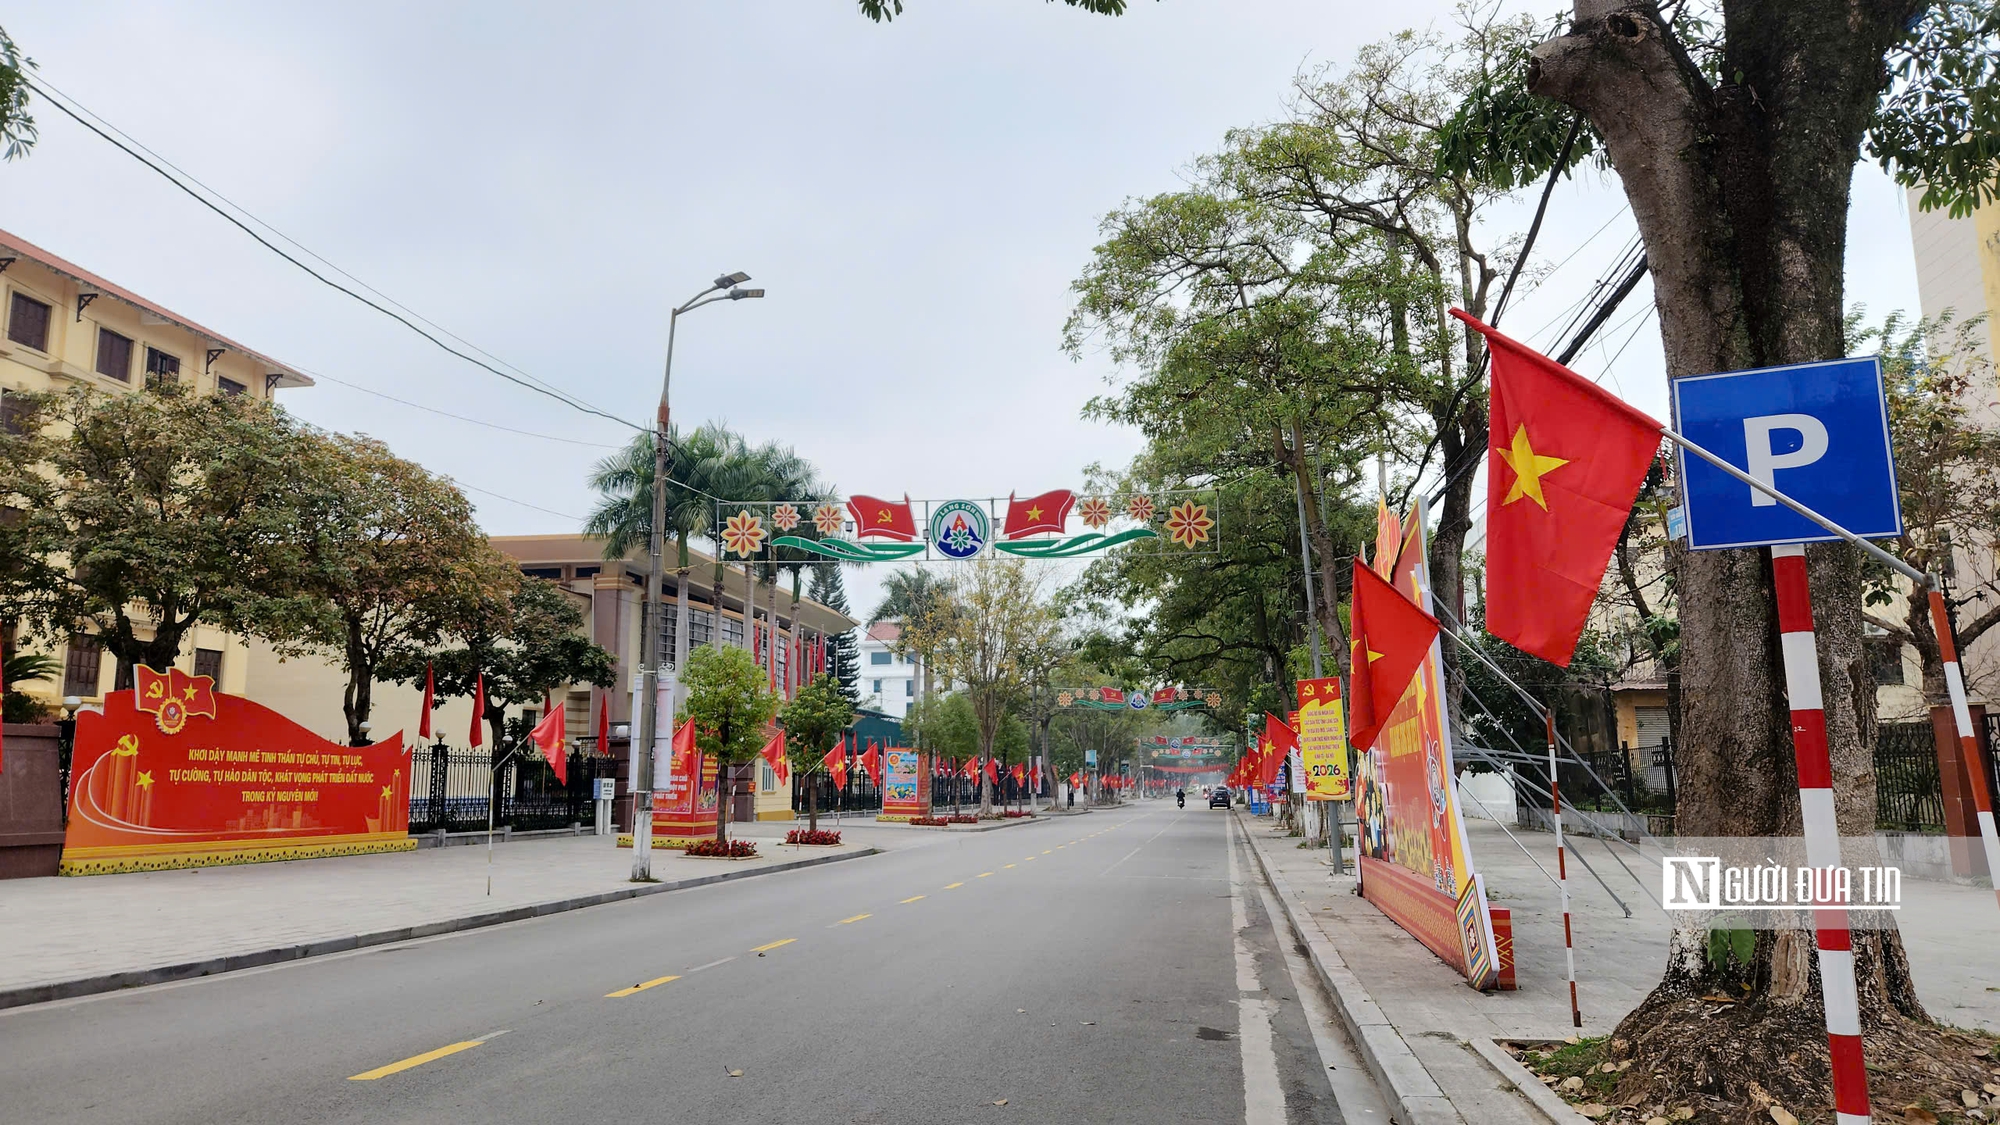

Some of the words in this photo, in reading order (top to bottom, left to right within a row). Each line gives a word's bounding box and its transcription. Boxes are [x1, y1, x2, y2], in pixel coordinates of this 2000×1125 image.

[1743, 413, 1829, 507] P
[188, 749, 207, 761] KHƠI
[209, 747, 225, 765] DẬY
[226, 750, 248, 765] MẠNH
[249, 749, 260, 763] MẼ
[261, 752, 277, 763] TINH
[296, 753, 306, 767] TỰ
[306, 750, 320, 766] CHỦ,
[322, 754, 330, 768] TỰ
[331, 755, 341, 766] TIN,
[342, 755, 351, 768] TỰ
[351, 755, 363, 768] LỰC,
[169, 768, 181, 785] TỰ
[181, 767, 211, 783] CƯỜNG,
[213, 769, 224, 785] TỰ
[225, 768, 240, 782] HÀO
[241, 768, 257, 782] DÂN
[259, 769, 274, 785] TỘC,
[275, 769, 292, 783] KHÁT
[293, 772, 311, 786] VỌNG
[312, 770, 328, 783] PHÁT
[329, 768, 345, 783] TRIỂN
[358, 771, 374, 783] NƯỚC
[1312, 764, 1341, 776] 2026
[241, 791, 265, 802] TRONG
[266, 787, 276, 802] KỶ
[277, 788, 303, 802] NGUYÊN
[304, 788, 319, 802] MỚI!
